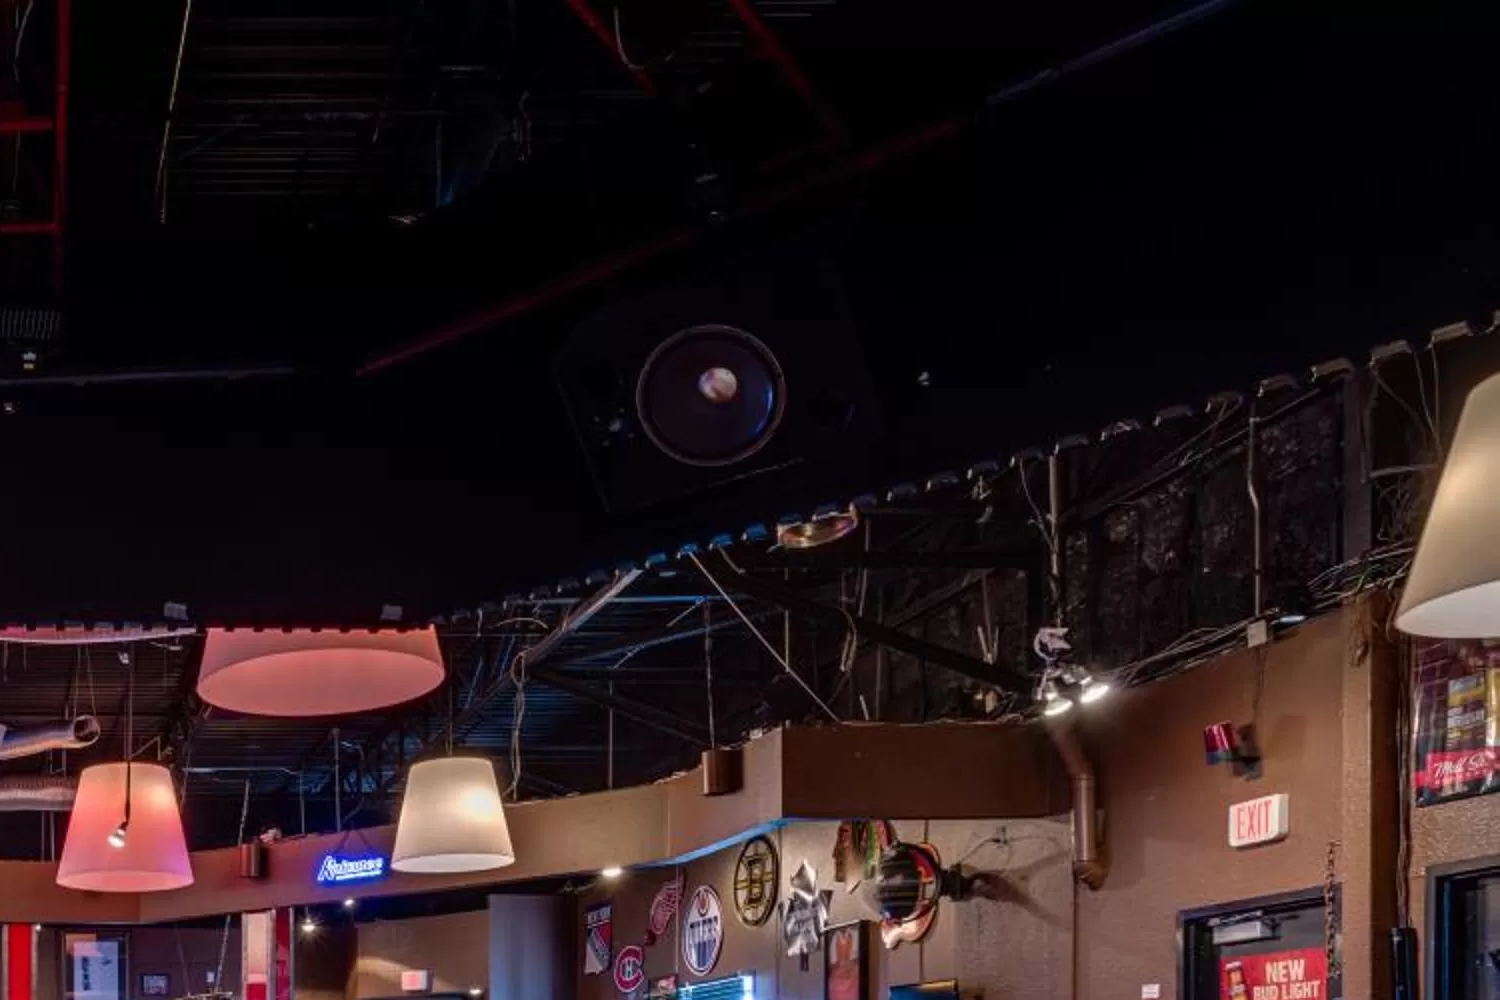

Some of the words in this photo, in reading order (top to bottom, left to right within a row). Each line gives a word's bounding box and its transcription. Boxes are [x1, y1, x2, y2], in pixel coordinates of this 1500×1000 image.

[1236, 800, 1272, 839] EXIT
[1265, 959, 1306, 984] NEW
[1281, 980, 1321, 1000] LIGHT
